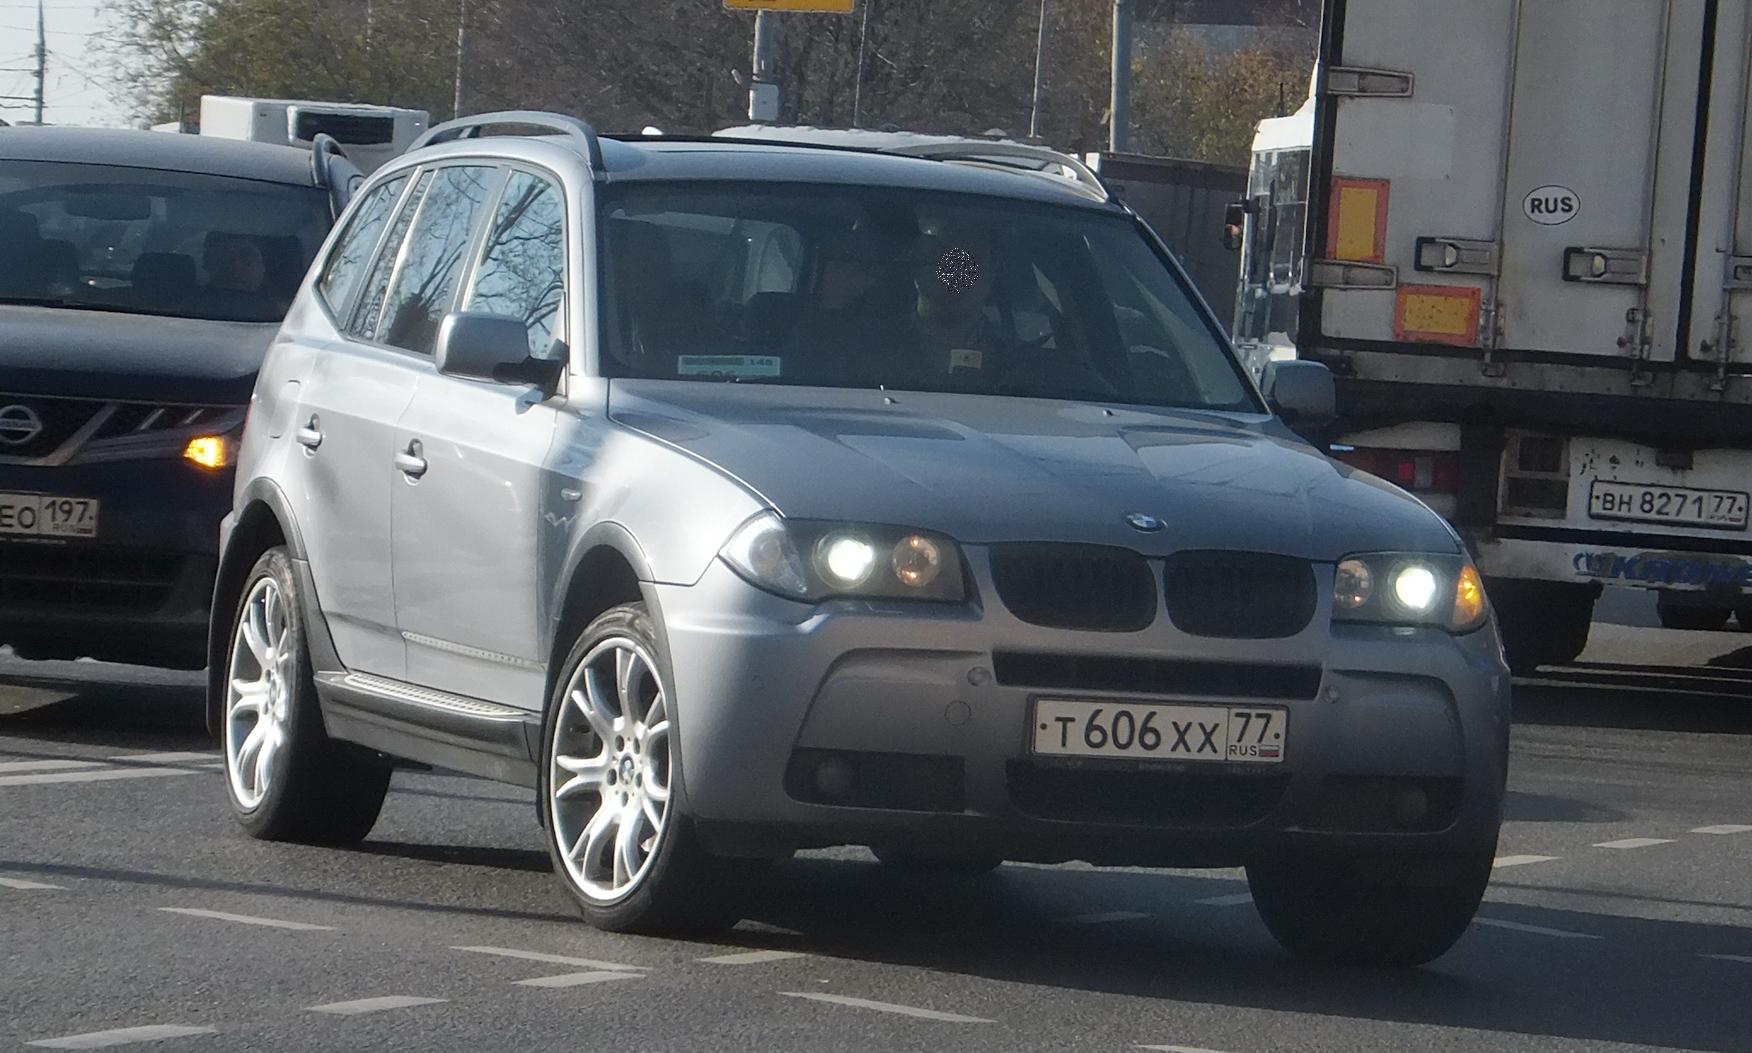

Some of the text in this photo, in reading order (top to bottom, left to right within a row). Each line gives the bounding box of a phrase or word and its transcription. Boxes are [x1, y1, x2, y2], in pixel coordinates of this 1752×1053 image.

[1531, 196, 1573, 213] RUS
[44, 500, 89, 522] 197
[1713, 495, 1738, 514] 77
[1234, 713, 1273, 744] 77
[1229, 745, 1257, 757] RUS
